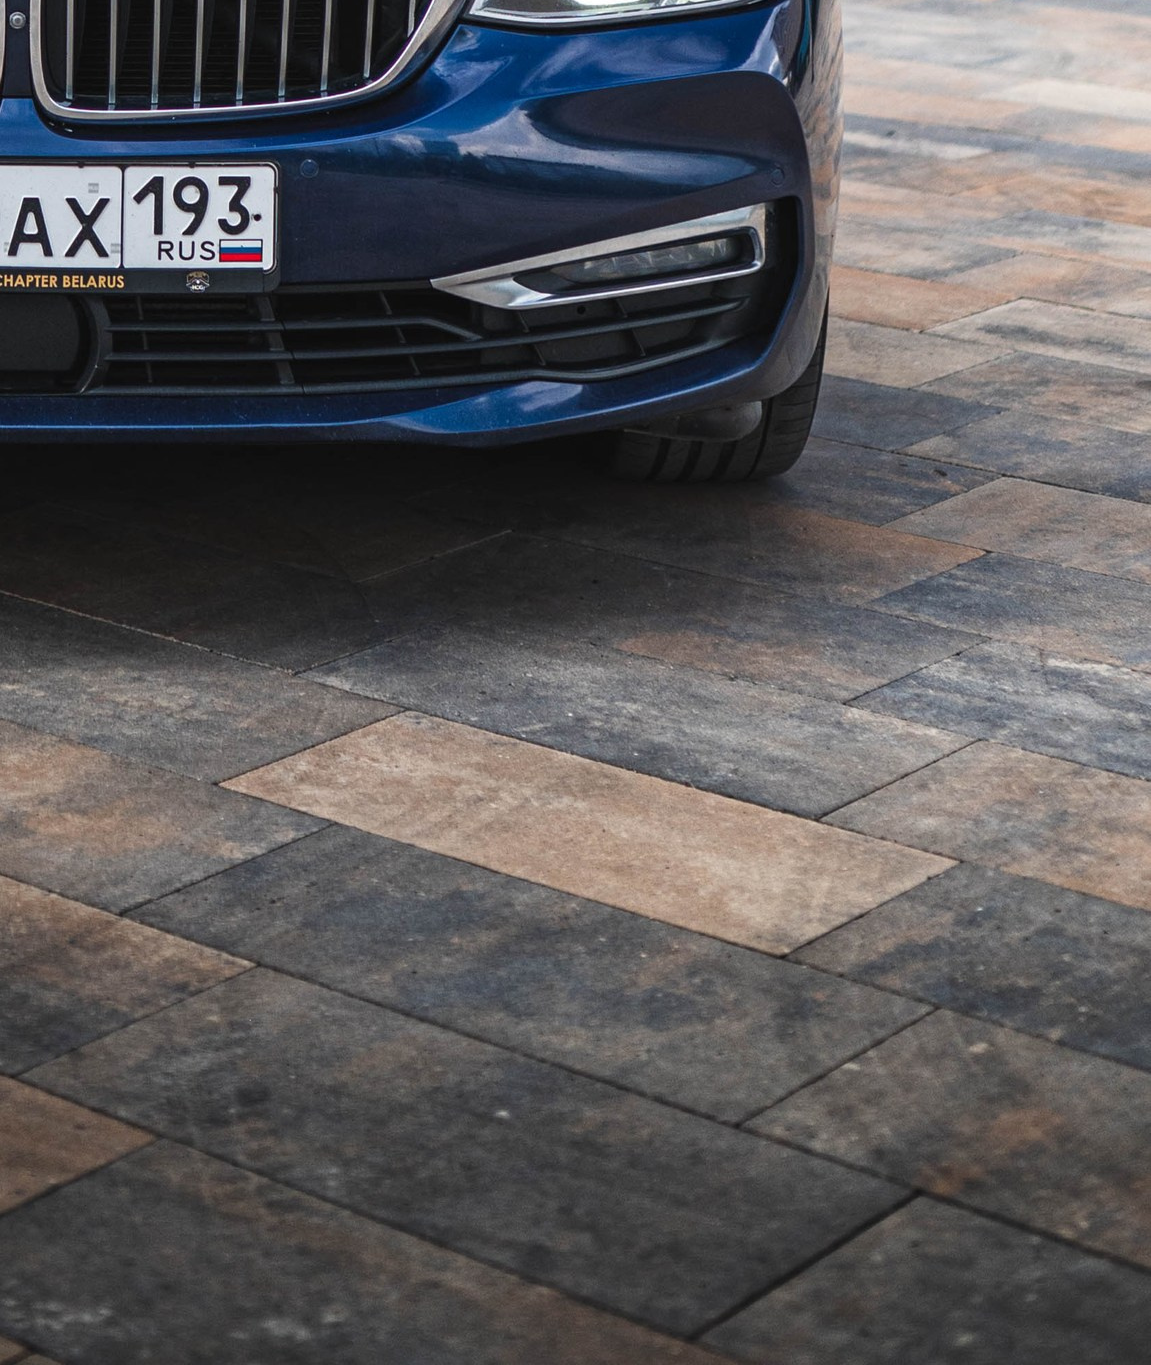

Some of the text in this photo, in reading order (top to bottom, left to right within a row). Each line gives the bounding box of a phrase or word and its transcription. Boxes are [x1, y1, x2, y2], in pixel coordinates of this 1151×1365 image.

[133, 176, 251, 236] 193
[157, 240, 216, 261] RUS
[62, 275, 125, 289] BELARUS
